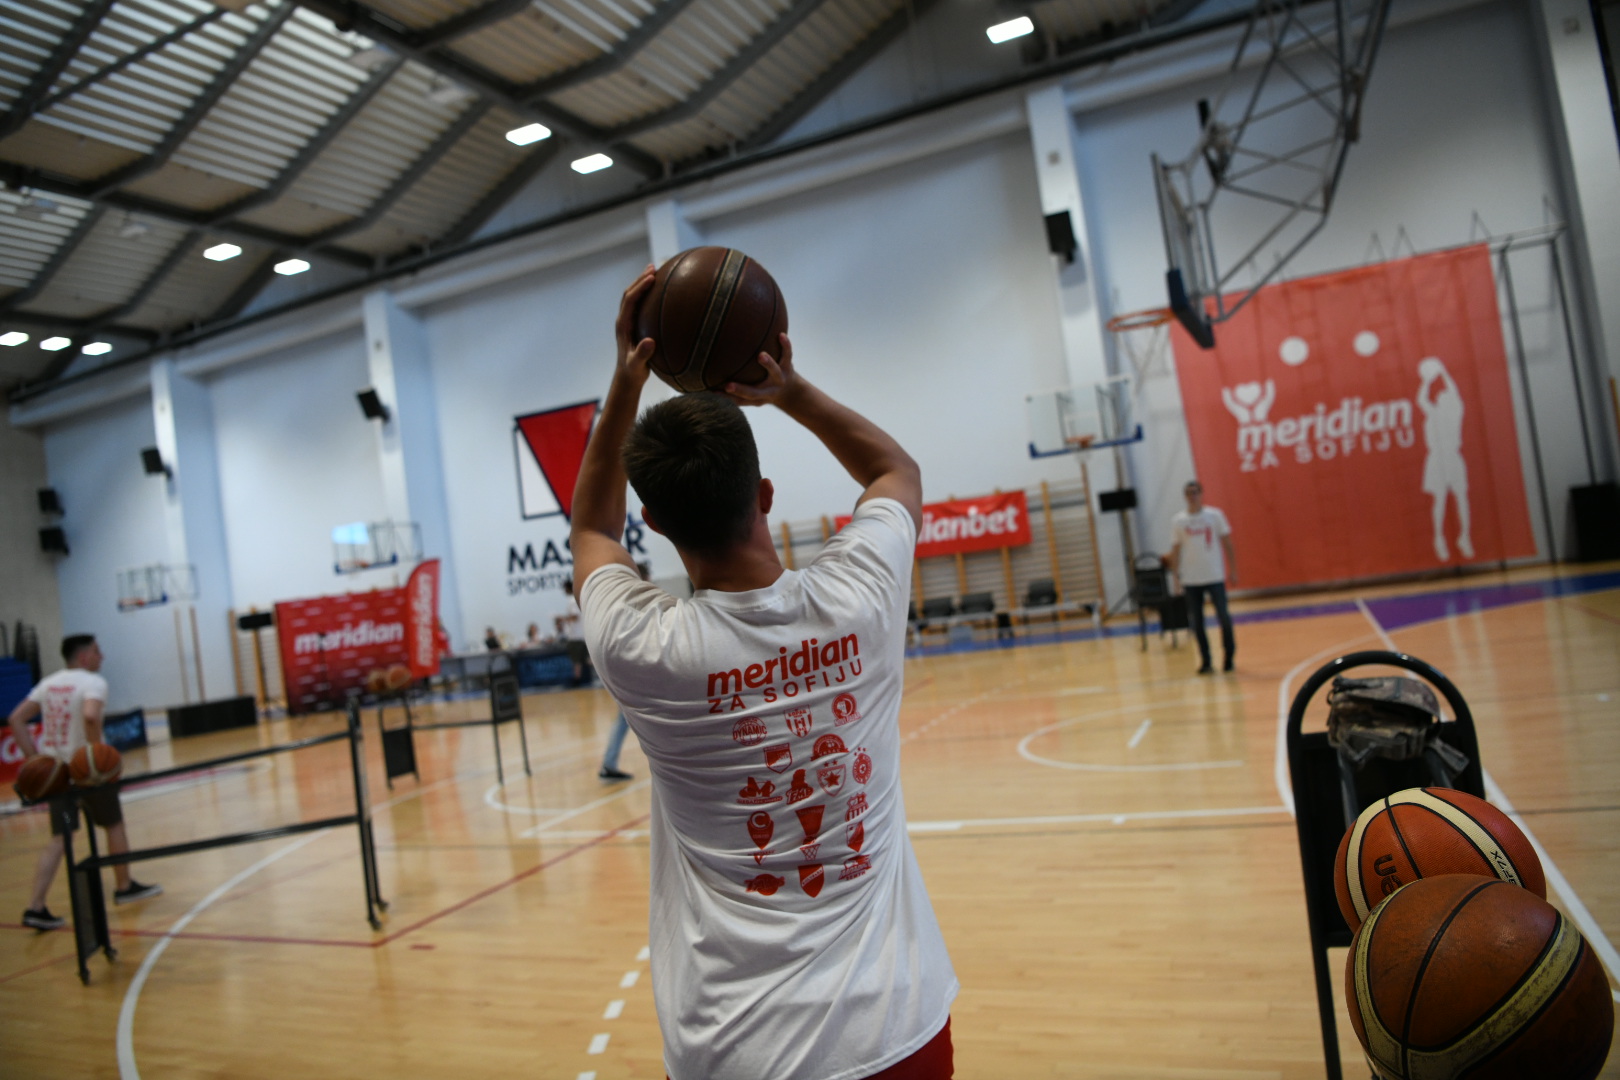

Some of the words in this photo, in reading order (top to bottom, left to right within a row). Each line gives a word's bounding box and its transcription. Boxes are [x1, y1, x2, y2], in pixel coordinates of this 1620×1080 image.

[1237, 397, 1412, 455] meridian
[1240, 451, 1279, 472] ZA
[1295, 427, 1415, 463] SOFIJU
[918, 505, 1019, 543] ianbet
[294, 620, 404, 655] meridian
[707, 633, 859, 697] meridian
[708, 694, 746, 714] ZA
[763, 658, 863, 703] SOFIJU
[732, 725, 768, 741] DYNAMIC
